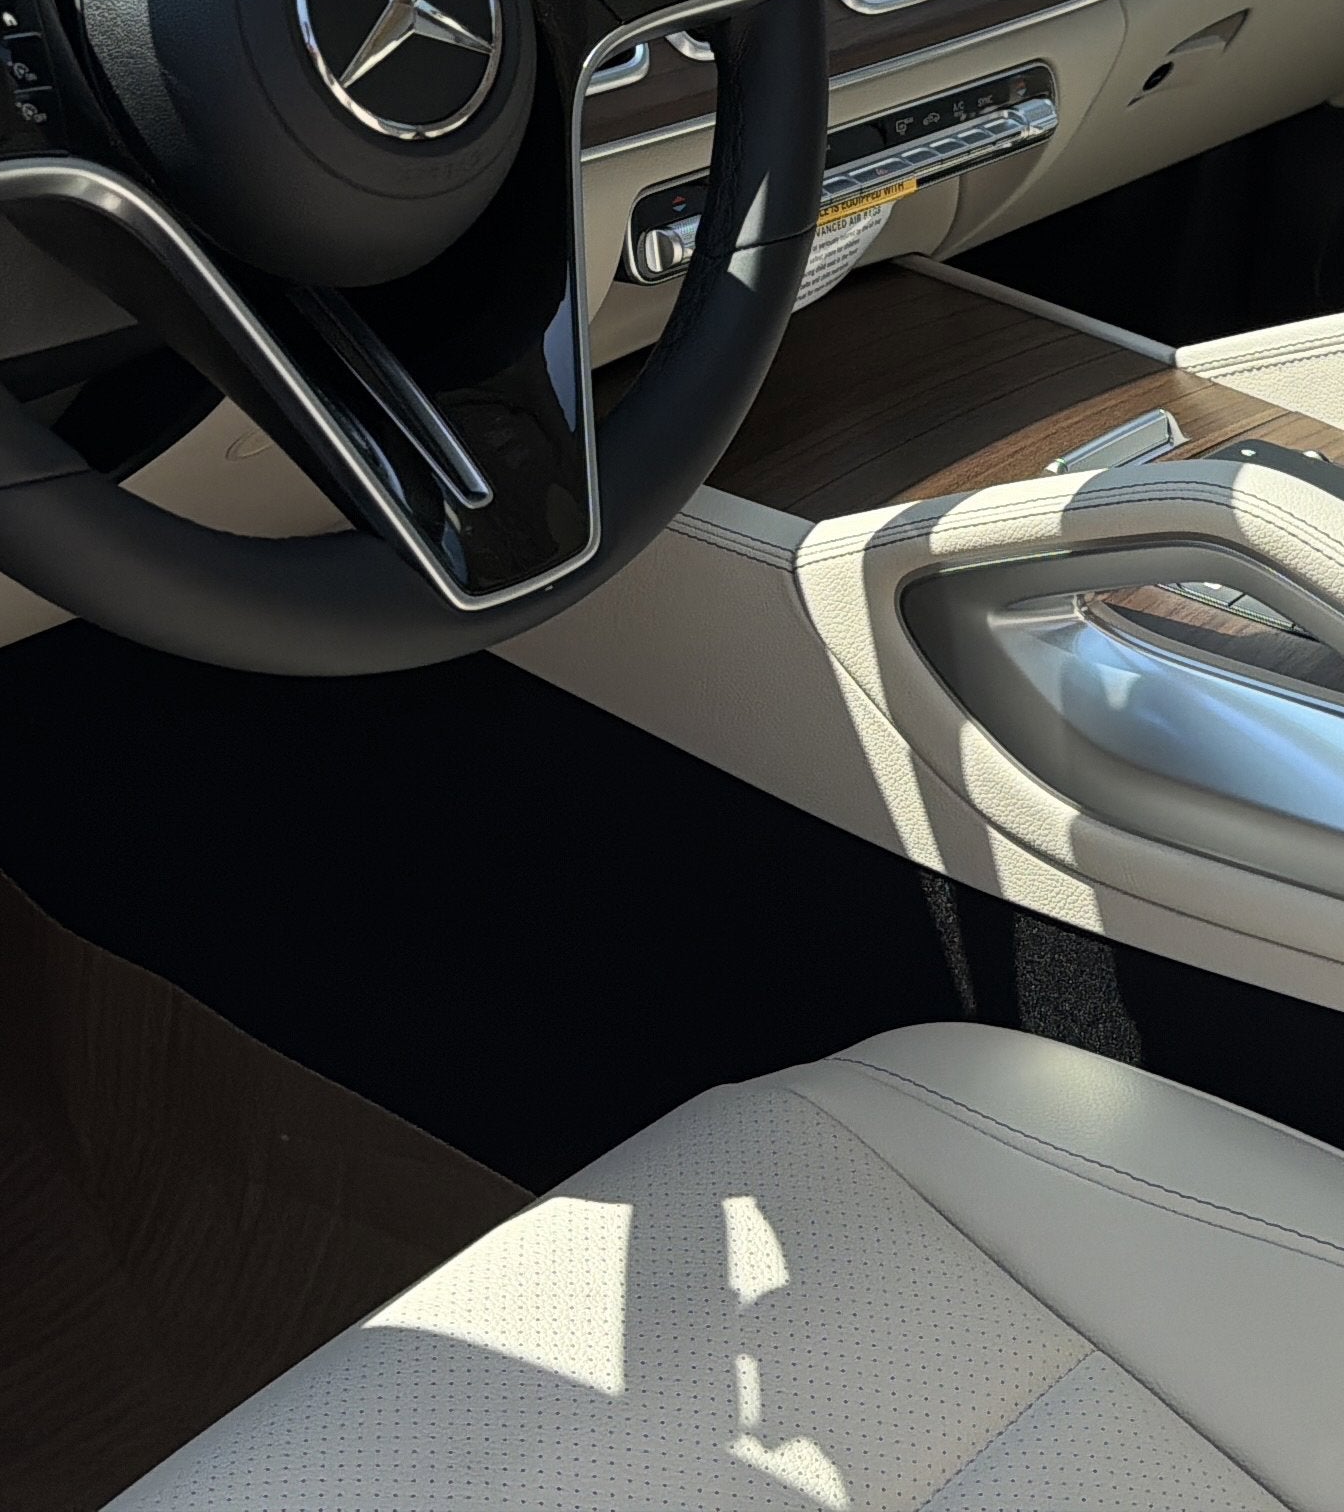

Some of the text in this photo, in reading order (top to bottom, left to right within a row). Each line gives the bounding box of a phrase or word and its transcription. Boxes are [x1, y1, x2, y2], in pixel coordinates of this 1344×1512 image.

[883, 181, 904, 196] WITH
[816, 220, 848, 237] VANCED
[849, 213, 862, 226] AIR
